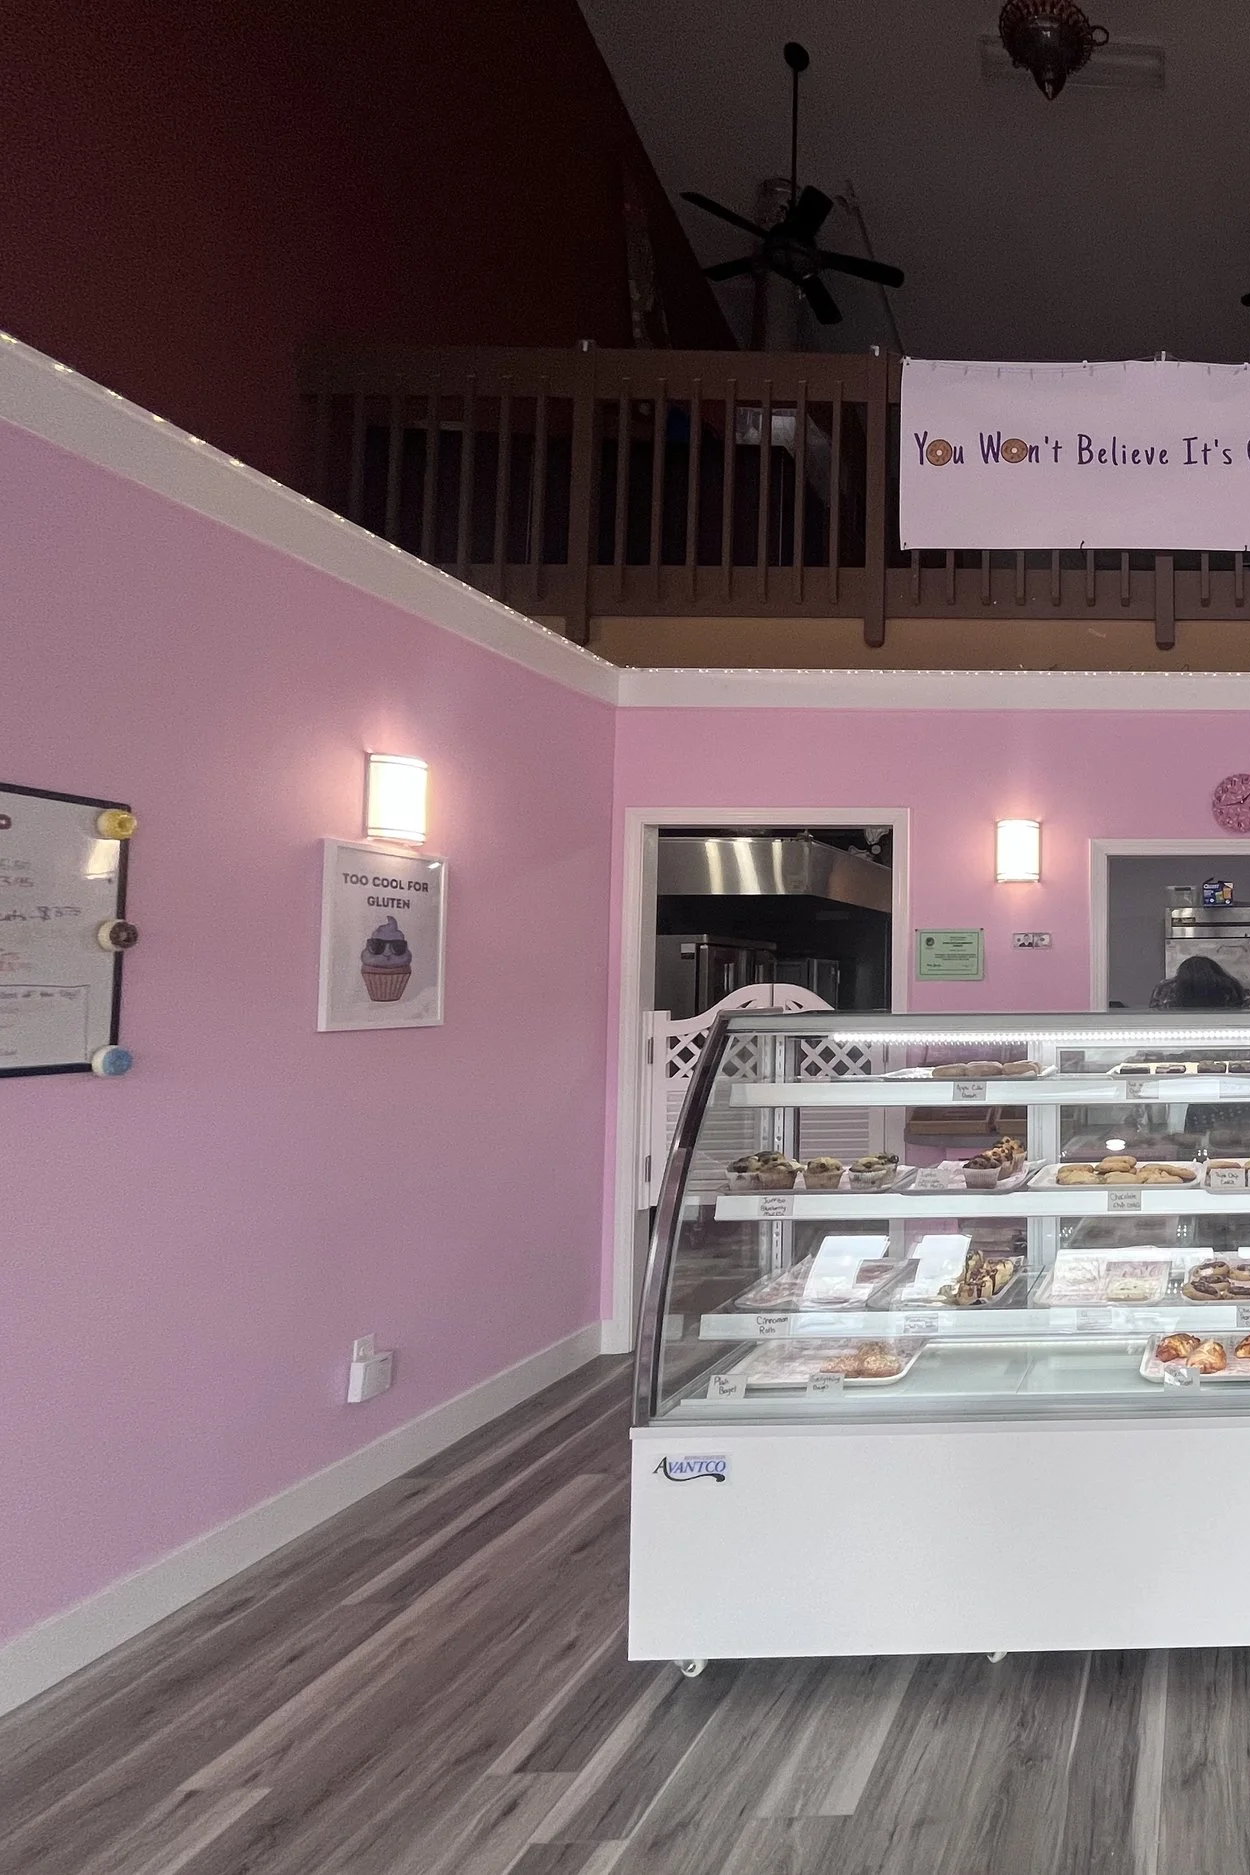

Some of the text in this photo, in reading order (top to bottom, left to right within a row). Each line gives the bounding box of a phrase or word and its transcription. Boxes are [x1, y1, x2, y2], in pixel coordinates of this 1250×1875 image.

[913, 430, 965, 467] You
[979, 430, 1063, 464] Won't
[1077, 433, 1169, 466] Believe
[1182, 436, 1233, 466] It's
[342, 872, 429, 893] TOO COOL FOR
[366, 895, 411, 909] GLUTEN
[756, 1315, 789, 1325] Cinnamon
[719, 1385, 737, 1397] Bagel
[652, 1456, 726, 1483] AVANTCO
